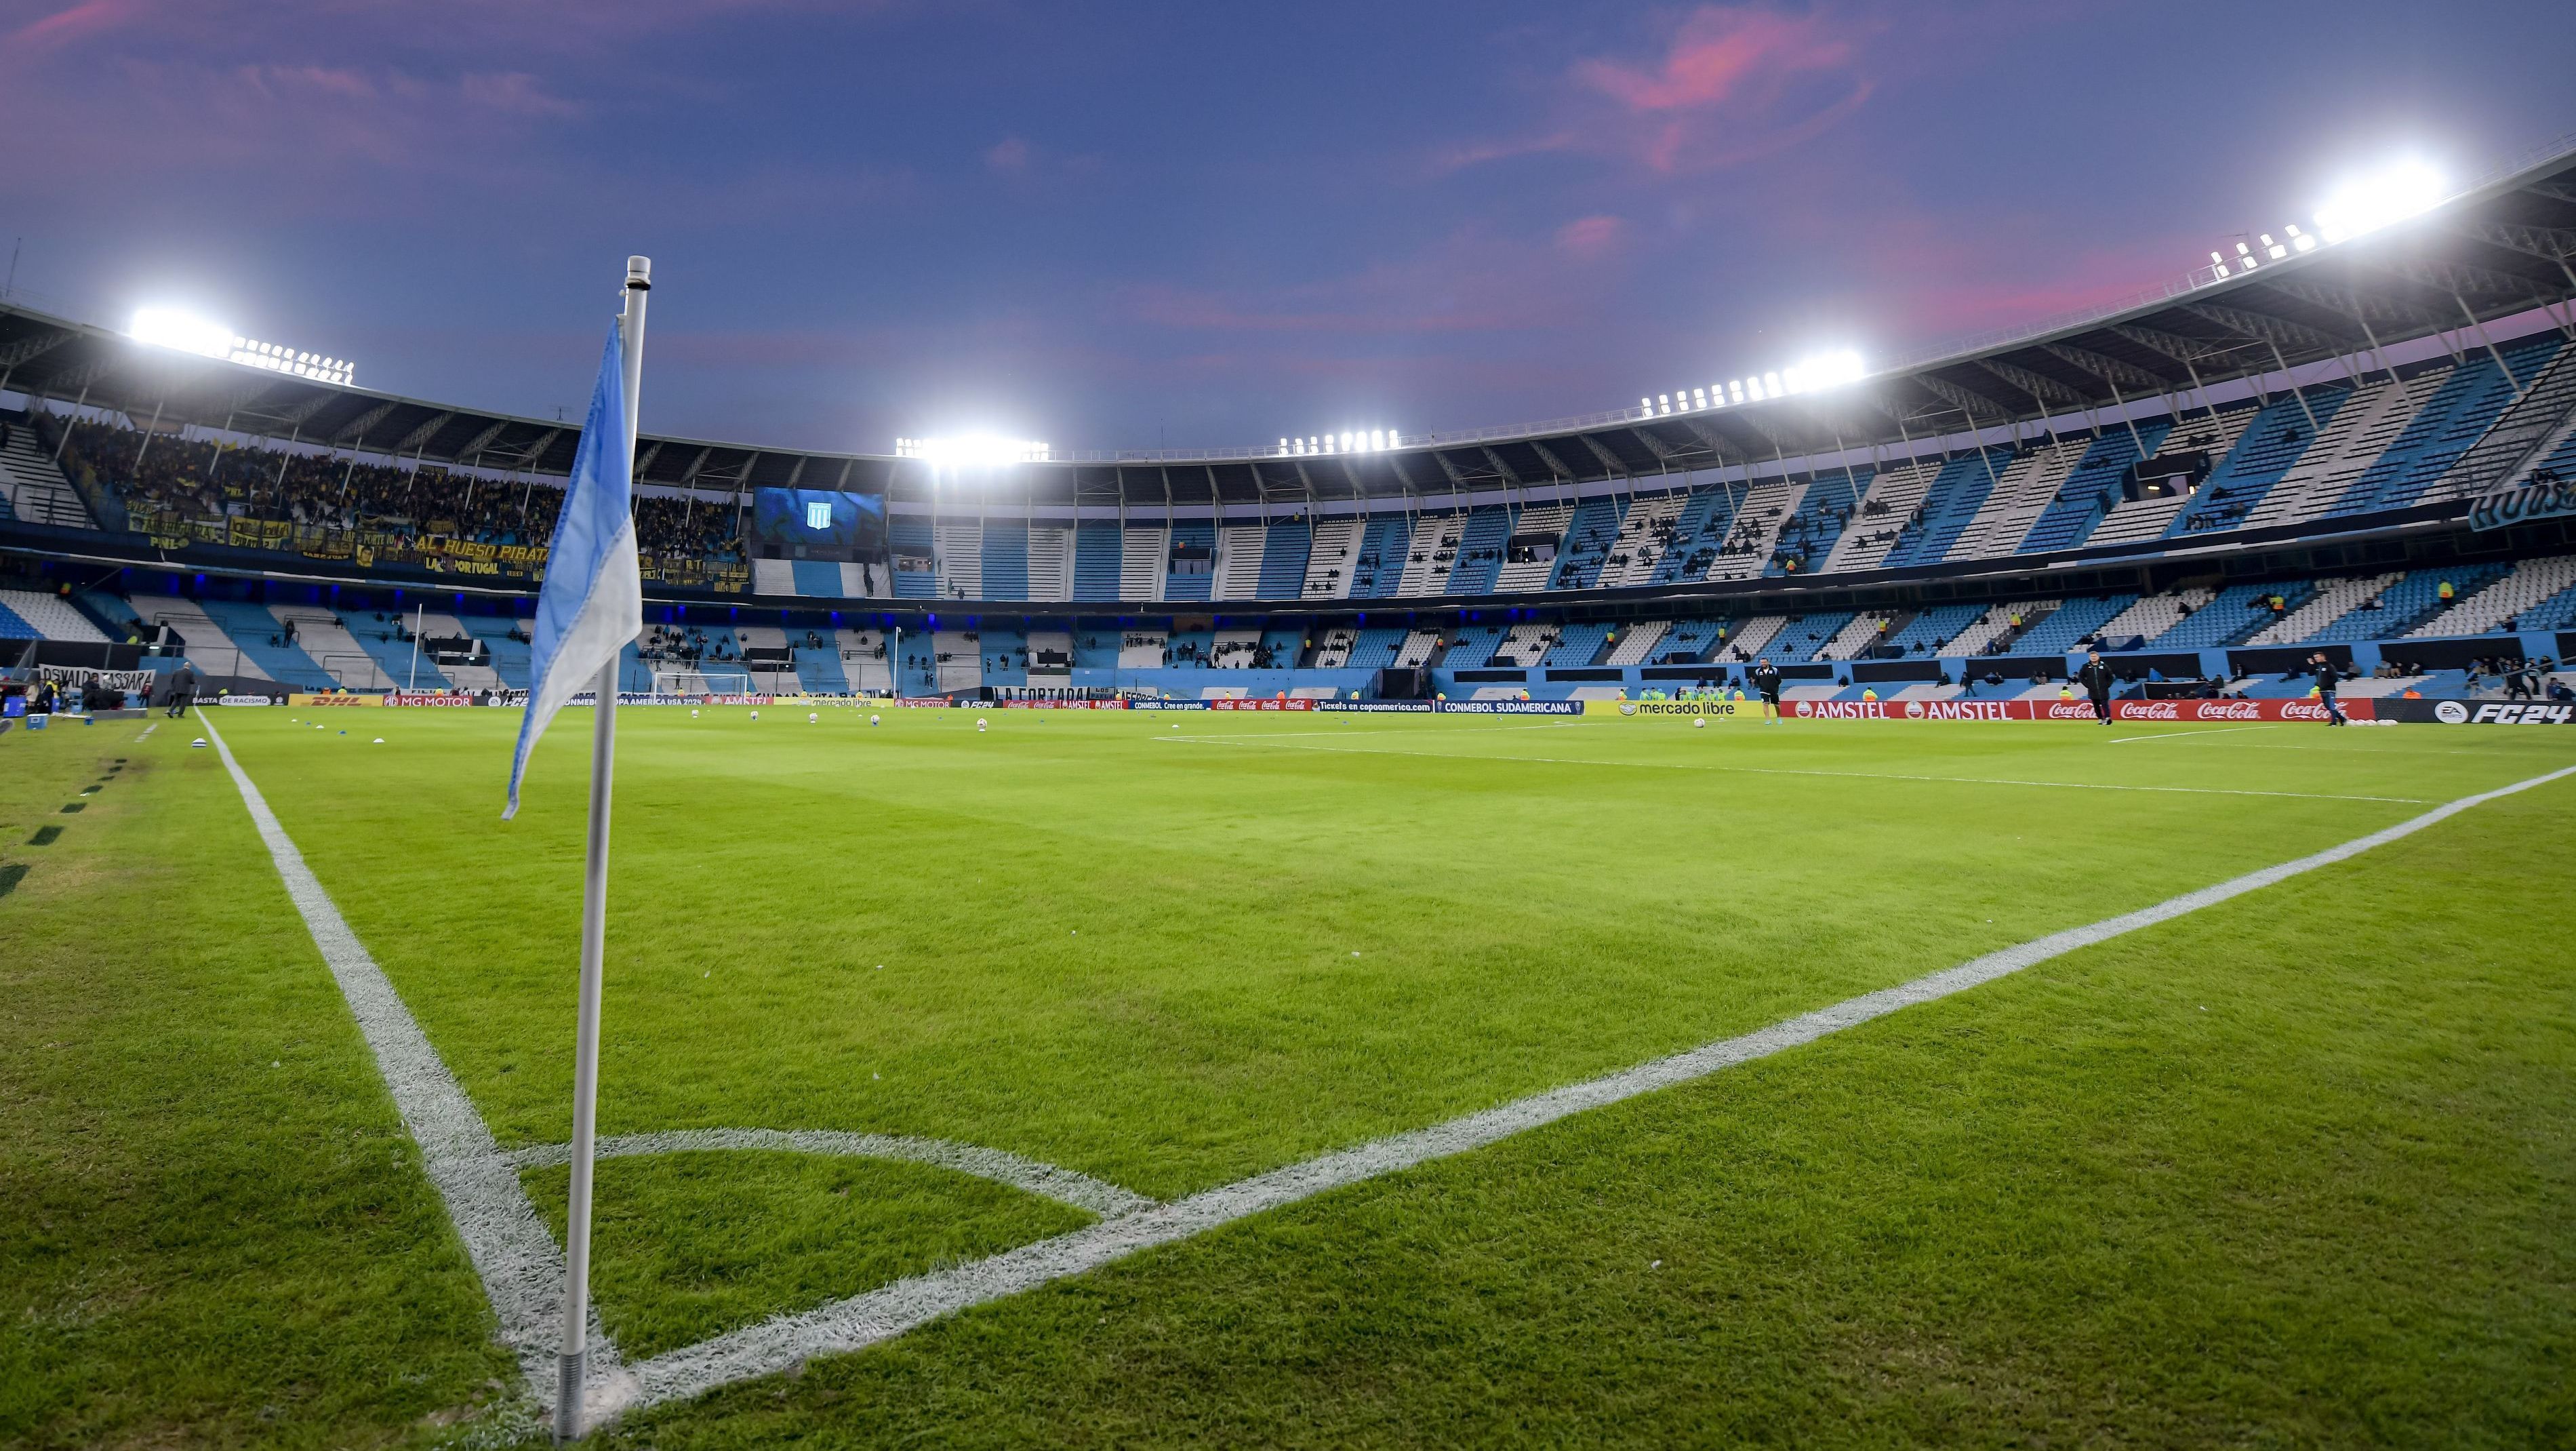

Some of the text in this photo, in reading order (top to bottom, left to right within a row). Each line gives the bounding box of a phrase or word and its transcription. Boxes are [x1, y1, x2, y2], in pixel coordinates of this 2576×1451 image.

[416, 535, 436, 550] AL
[444, 539, 496, 557] HUESO
[43, 667, 99, 689] OSVALD
[995, 688, 1012, 700] LA
[310, 697, 361, 706] DHL
[401, 697, 470, 706] MG MOTOR
[502, 698, 529, 706] FC2
[1068, 701, 1091, 709] AMSTEL
[1101, 701, 1124, 710] AMSTEL
[1320, 702, 1347, 710] Tickets
[1360, 702, 1430, 712] copaamerica.com
[1445, 702, 1571, 713] CONMEBOL SUDAMERICANA
[1640, 702, 1735, 715] mercado libre
[1815, 702, 1890, 719] AMSTEL
[1928, 702, 2013, 721] AMSTEL
[2120, 702, 2179, 719] Coca-Cola
[2197, 702, 2260, 719] Coca-Cola
[2441, 706, 2462, 714] EA
[2472, 704, 2574, 724] FC24
